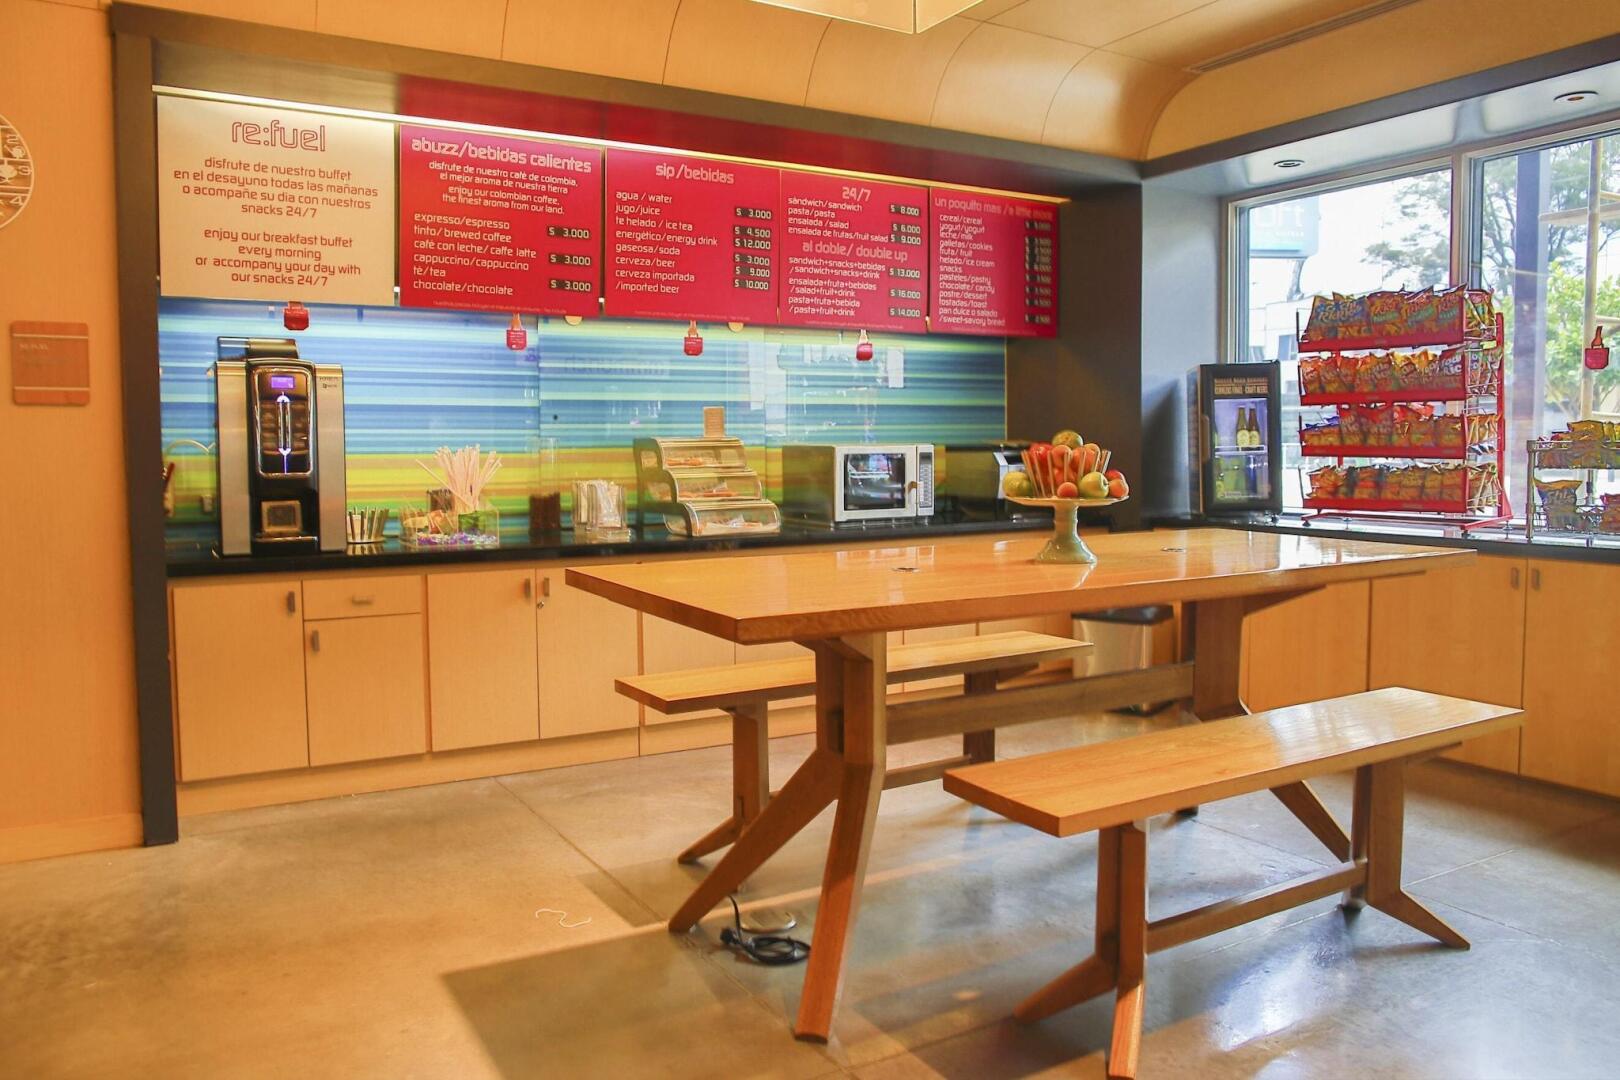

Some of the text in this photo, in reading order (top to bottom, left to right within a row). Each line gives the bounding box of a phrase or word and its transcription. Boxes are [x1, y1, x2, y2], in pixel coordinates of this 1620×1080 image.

[231, 119, 325, 152] re:fuel
[411, 136, 591, 173] abuzz/bebidas calientes
[204, 156, 351, 181] disfrute de nuestro buffet
[428, 160, 462, 172] disfrute
[462, 164, 474, 174] de
[475, 167, 508, 177] nuestro
[527, 172, 539, 181] de
[655, 162, 675, 179] sip
[173, 169, 378, 197] en el desayuno todas las mañanas
[439, 171, 568, 194] el mejor aroma de nuestra tierra
[182, 184, 190, 194] o
[192, 185, 257, 200] acompañe
[259, 191, 275, 201] su
[297, 194, 319, 205] con
[320, 196, 371, 209] nuestros
[447, 185, 473, 197] enjoy
[473, 188, 489, 196] our
[488, 189, 532, 201] colombian
[615, 191, 639, 201] agua
[647, 193, 672, 203] water
[841, 186, 871, 201] 24/7
[441, 192, 457, 203] the
[457, 193, 482, 205] finest
[482, 198, 510, 208] aroma
[510, 200, 529, 210] from
[530, 204, 544, 212] our
[615, 204, 660, 215] jugo/juice
[240, 203, 317, 218] snacks 24/7
[748, 208, 771, 219] 3.000
[413, 212, 510, 229] expresso/espresso
[625, 216, 656, 227] helado
[664, 219, 677, 230] ice
[678, 221, 693, 231] tea
[787, 216, 823, 226] ensalada
[203, 227, 352, 247] enjoy our breakfast buffet
[443, 227, 480, 240] brewed
[482, 231, 511, 243] coffee
[562, 227, 589, 238] 3.000
[746, 227, 770, 238] 4.500
[787, 226, 821, 236] ensalada
[821, 228, 832, 237] de
[869, 234, 888, 243] salad
[697, 235, 717, 246] drink
[742, 238, 771, 250] 12.000
[237, 245, 321, 261] every morning
[436, 241, 455, 250] con
[515, 247, 536, 258] latte
[615, 243, 680, 255] gaseosa/soda
[893, 250, 908, 263] up
[194, 256, 361, 276] or accompany your day with
[413, 253, 529, 270] cappuccino/cappuccino
[563, 254, 590, 266] 3.000
[615, 256, 675, 268] cerveza/beer
[746, 255, 770, 266] 3.000
[231, 272, 328, 286] our snacks 24/7
[614, 269, 695, 282] cerveza importada
[749, 267, 770, 277] 9.000
[412, 278, 513, 295] chocolate/chocolate
[564, 280, 591, 291] 3.000
[659, 283, 679, 293] beer
[745, 279, 769, 290] 10.000
